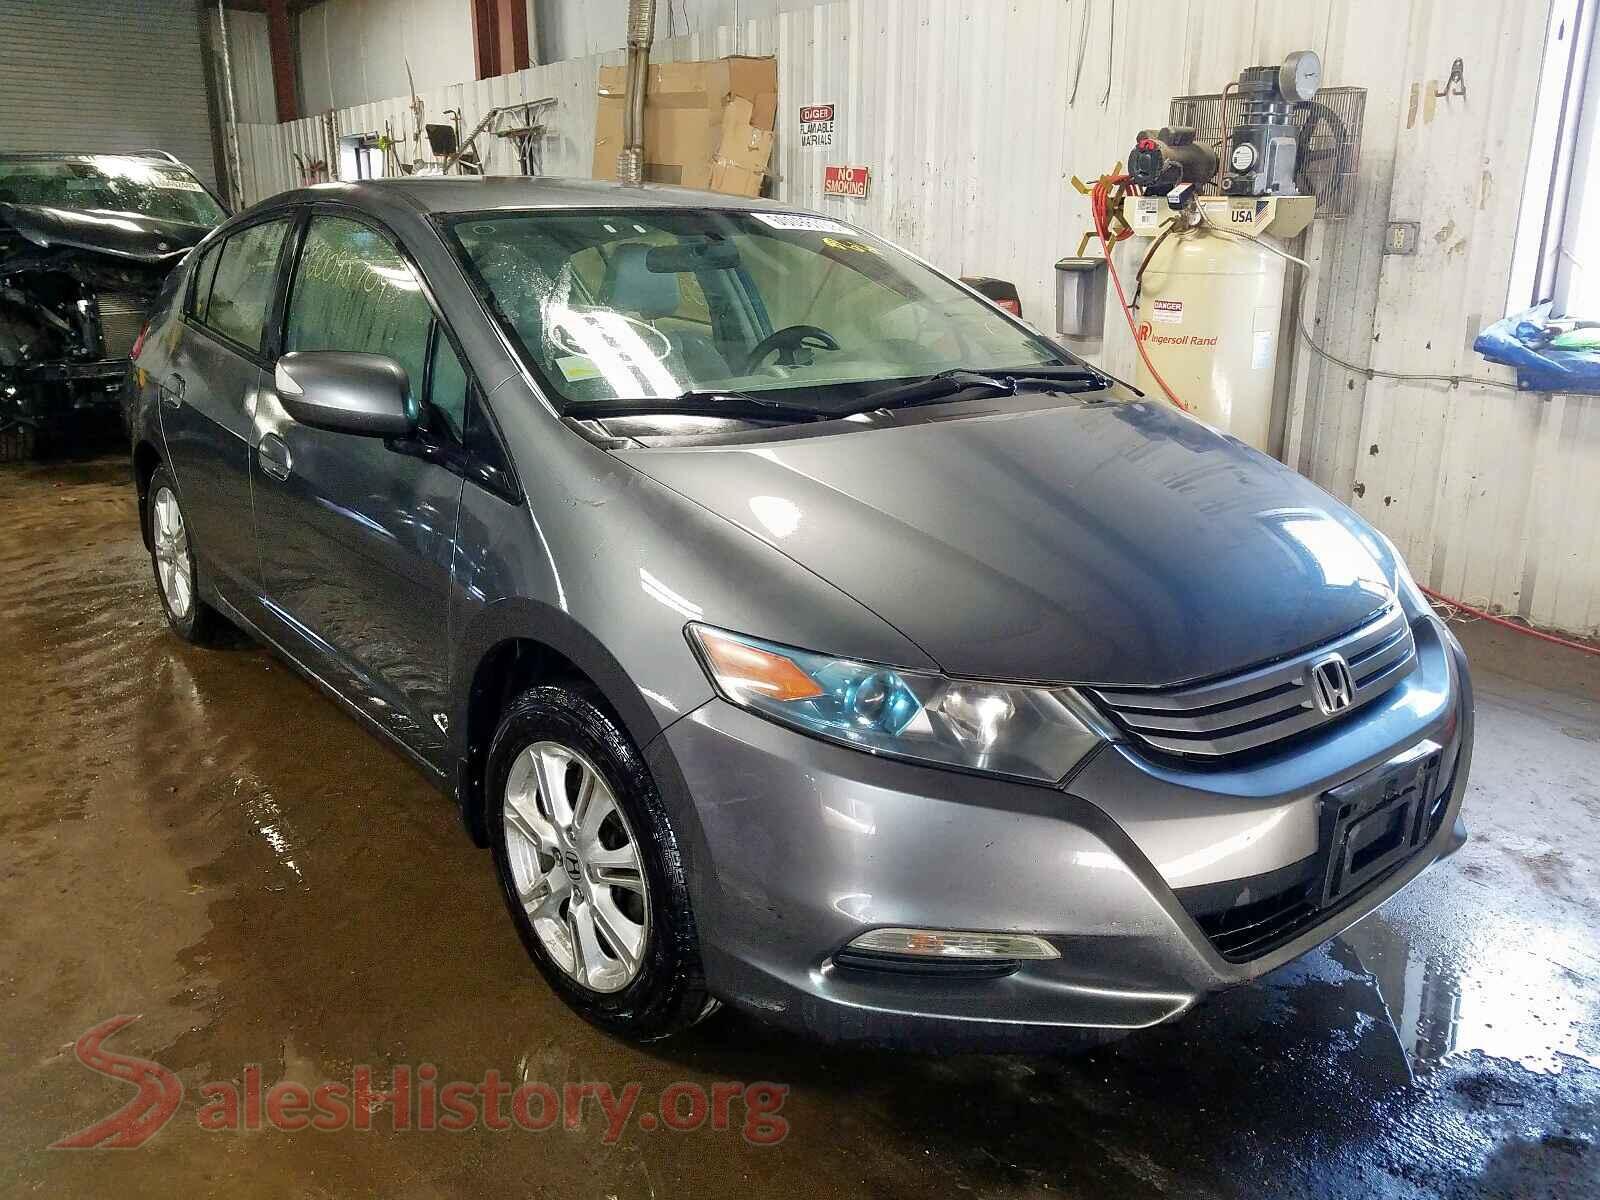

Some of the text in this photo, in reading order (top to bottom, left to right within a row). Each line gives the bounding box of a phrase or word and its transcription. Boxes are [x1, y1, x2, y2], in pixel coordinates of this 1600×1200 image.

[838, 169, 854, 180] NO
[825, 180, 864, 195] SMOKING
[1231, 210, 1252, 222] USA
[1154, 301, 1181, 310] DANGER
[1151, 335, 1218, 346] Ingersoll Rand
